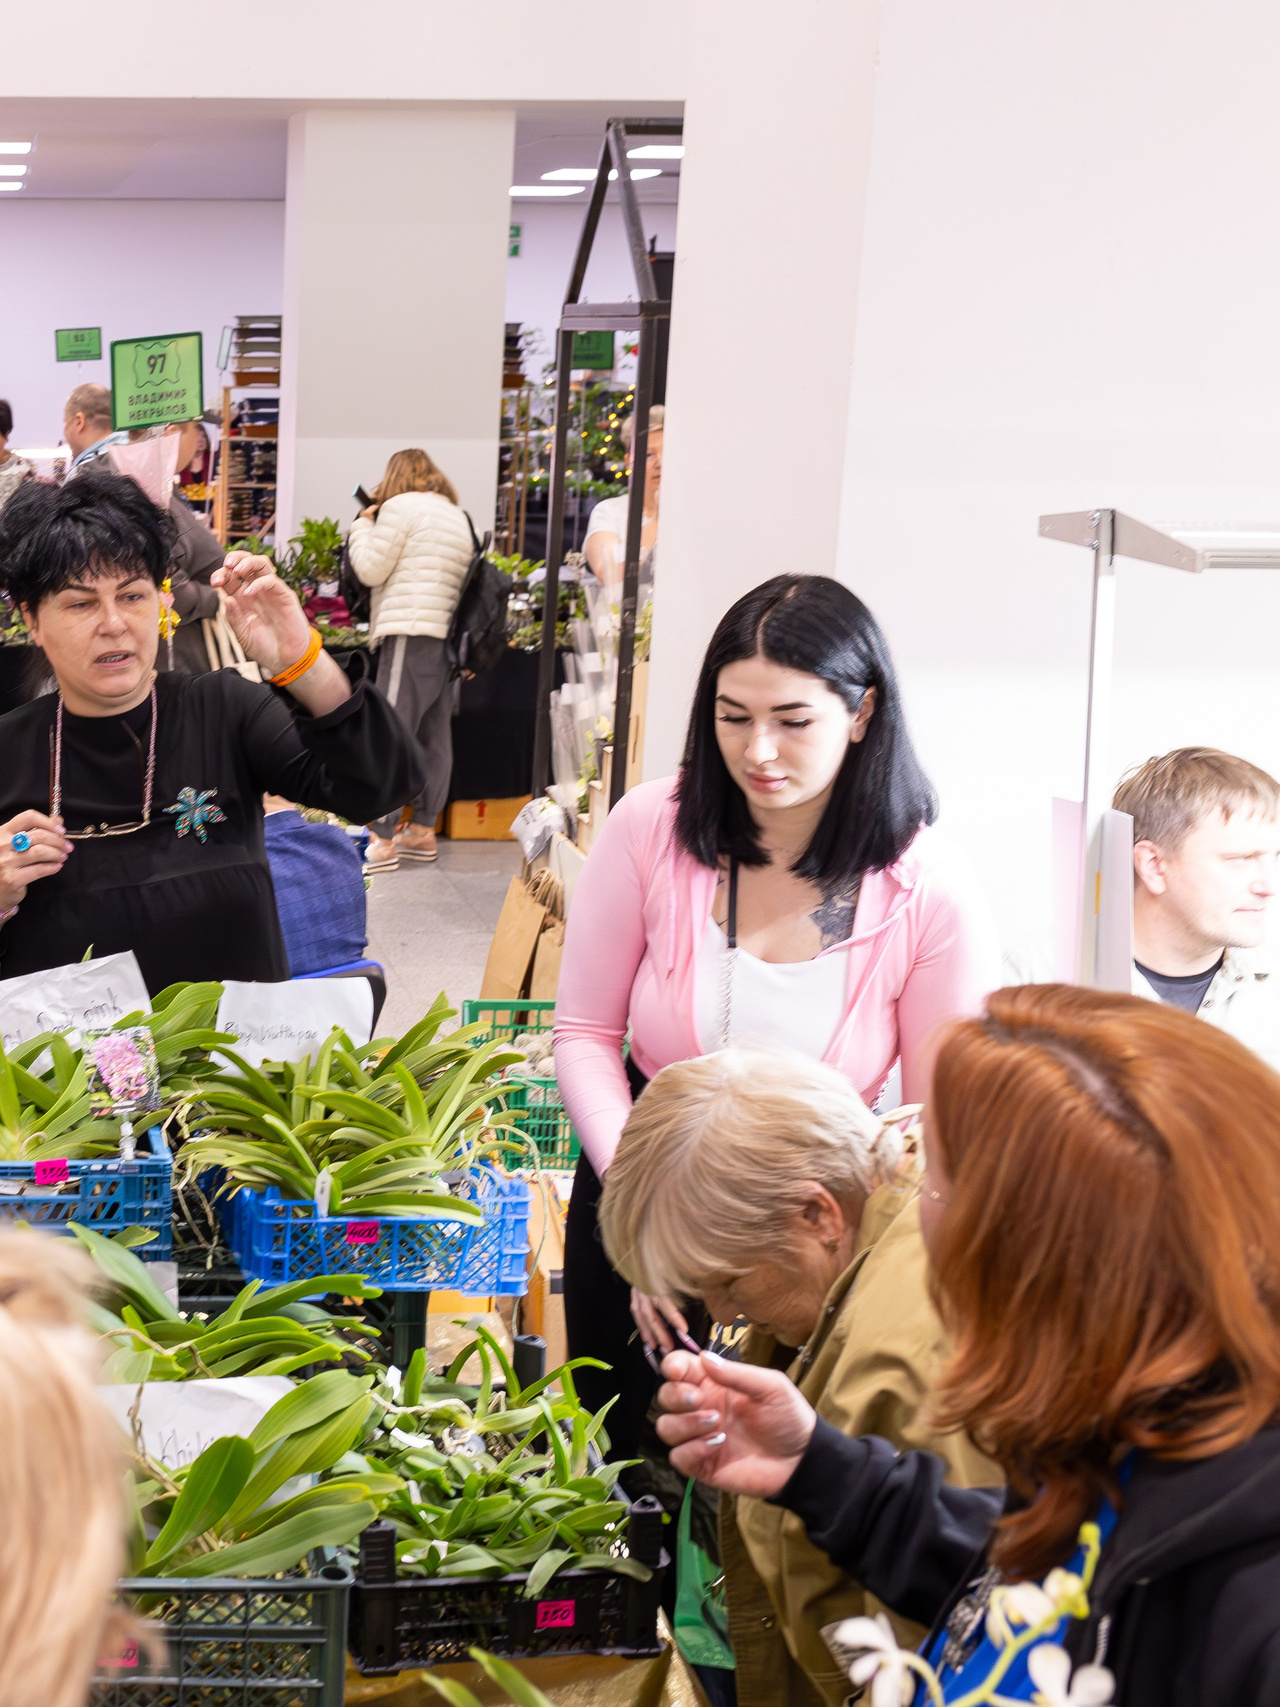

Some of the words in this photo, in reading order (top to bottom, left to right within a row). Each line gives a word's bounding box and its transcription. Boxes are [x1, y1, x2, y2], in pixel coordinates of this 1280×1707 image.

[147, 353, 167, 375] 97
[128, 388, 187, 407] ВЛАДИМИР
[128, 403, 188, 422] НЕКРЫЛОВ
